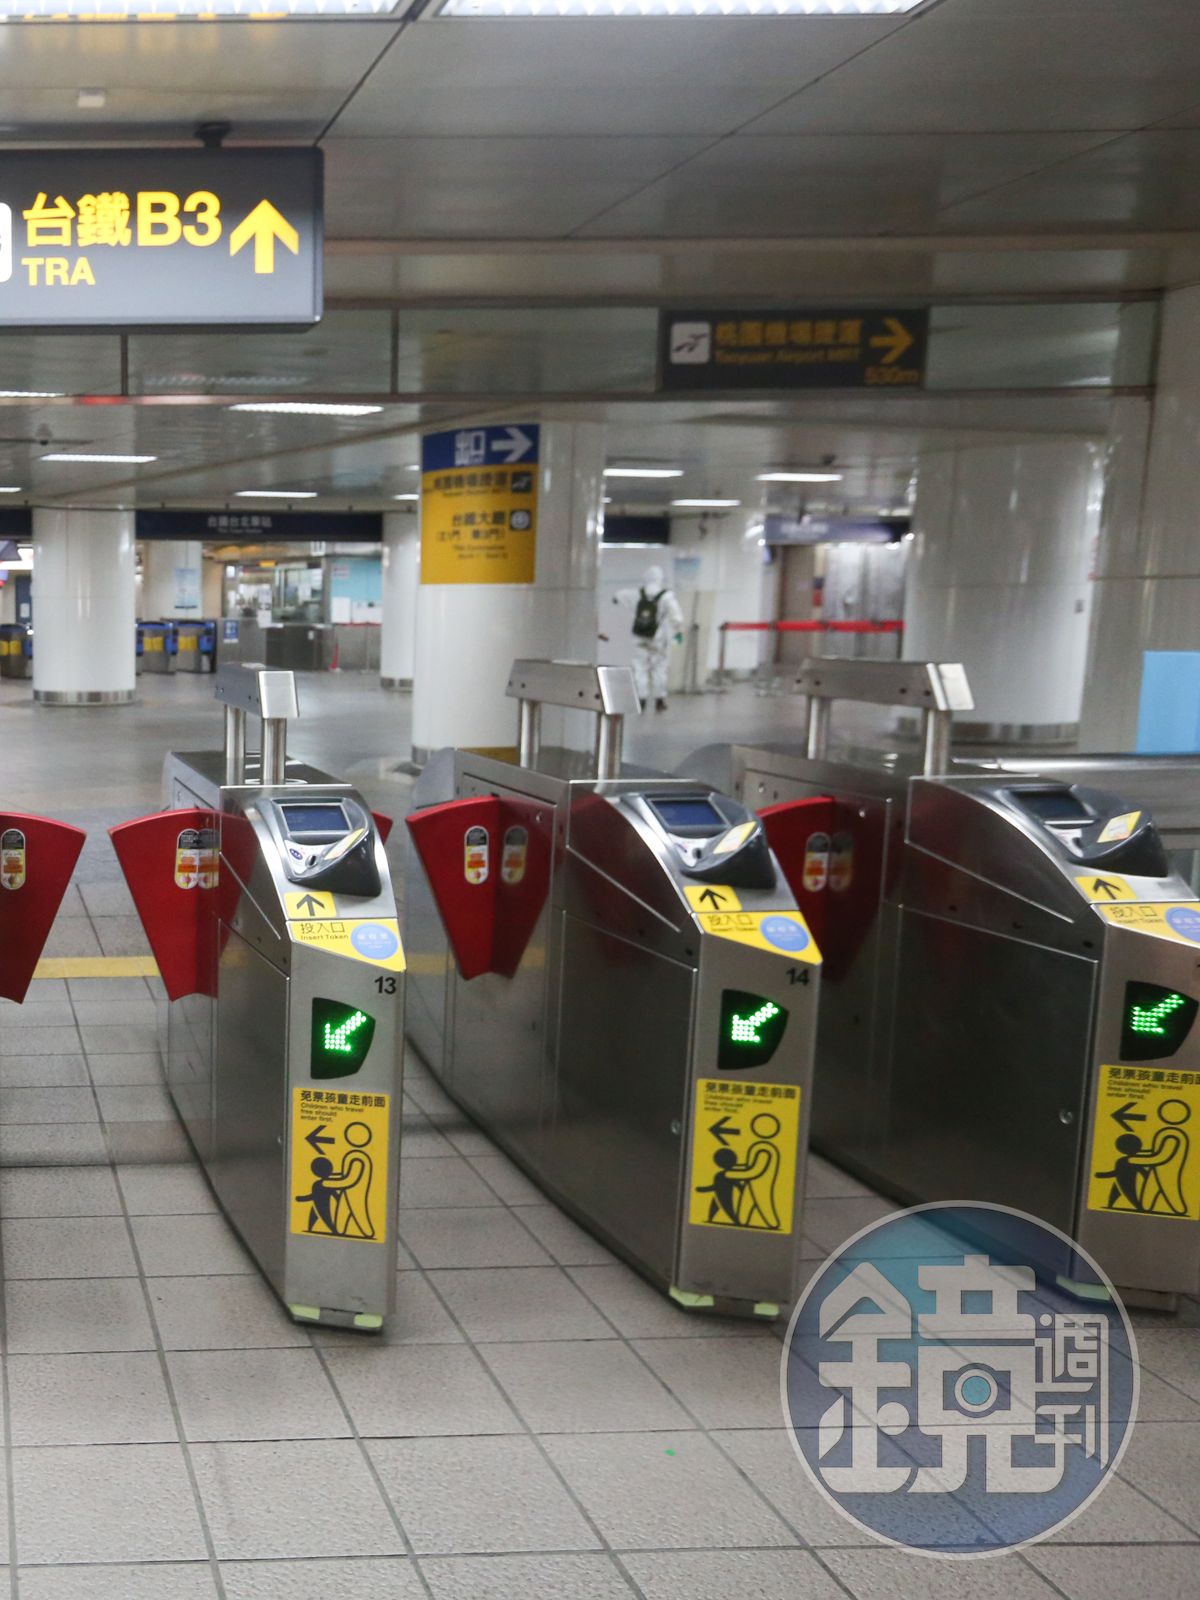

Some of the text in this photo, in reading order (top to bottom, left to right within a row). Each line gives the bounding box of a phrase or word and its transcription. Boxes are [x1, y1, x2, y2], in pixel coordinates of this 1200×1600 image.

[22, 191, 223, 247] 台鐵B3
[21, 257, 96, 286] TRA
[300, 922, 345, 934] 投入口
[374, 976, 396, 994] 13
[786, 967, 810, 985] 14
